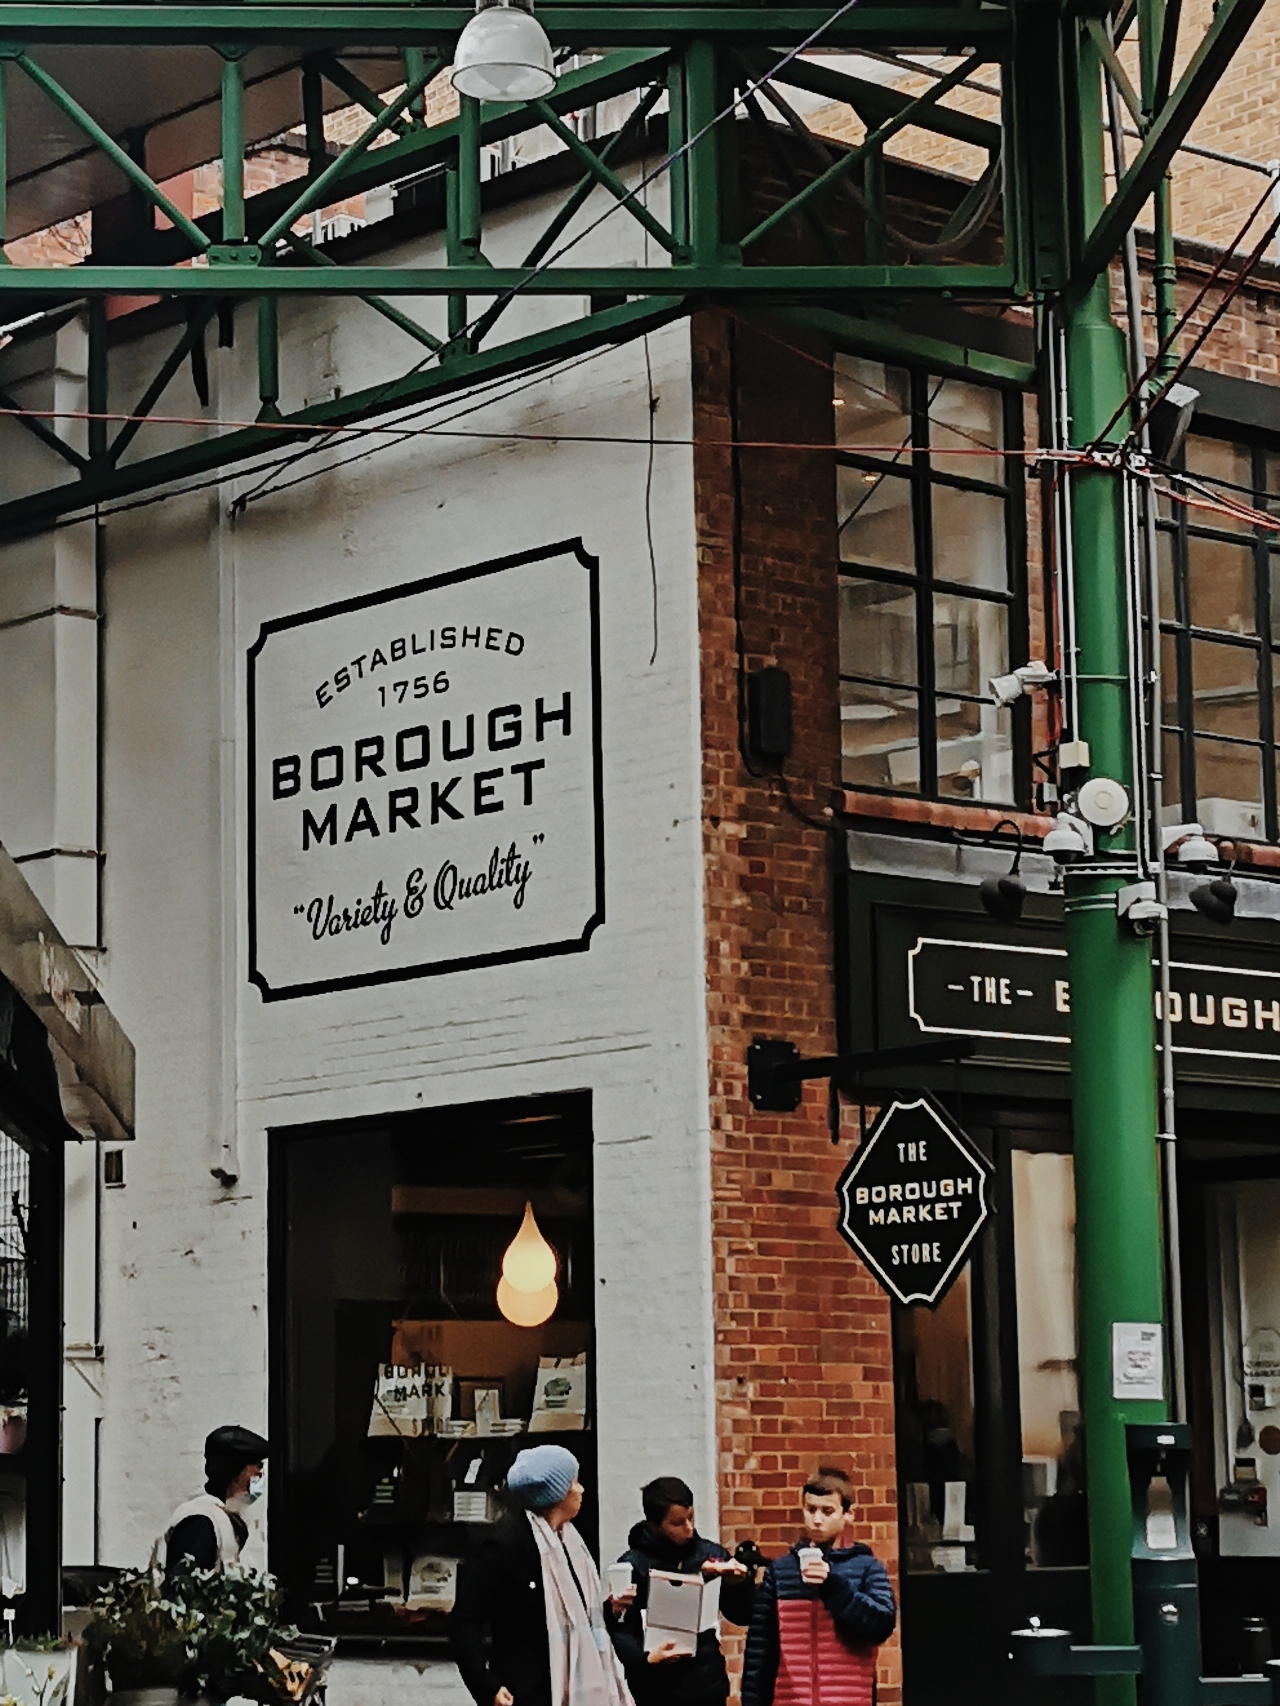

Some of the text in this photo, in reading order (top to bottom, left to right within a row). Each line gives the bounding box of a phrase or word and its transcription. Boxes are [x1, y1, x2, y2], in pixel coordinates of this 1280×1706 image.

[314, 625, 525, 709] ESTABLISHED
[377, 670, 450, 707] 1756
[272, 691, 572, 800] BOROUGH
[302, 758, 546, 851] MARKET
[404, 867, 428, 918] &
[897, 1140, 928, 1164] THE
[855, 1177, 973, 1205] BOROUGH
[868, 1201, 963, 1226] MARKET
[891, 1242, 942, 1266] STORE
